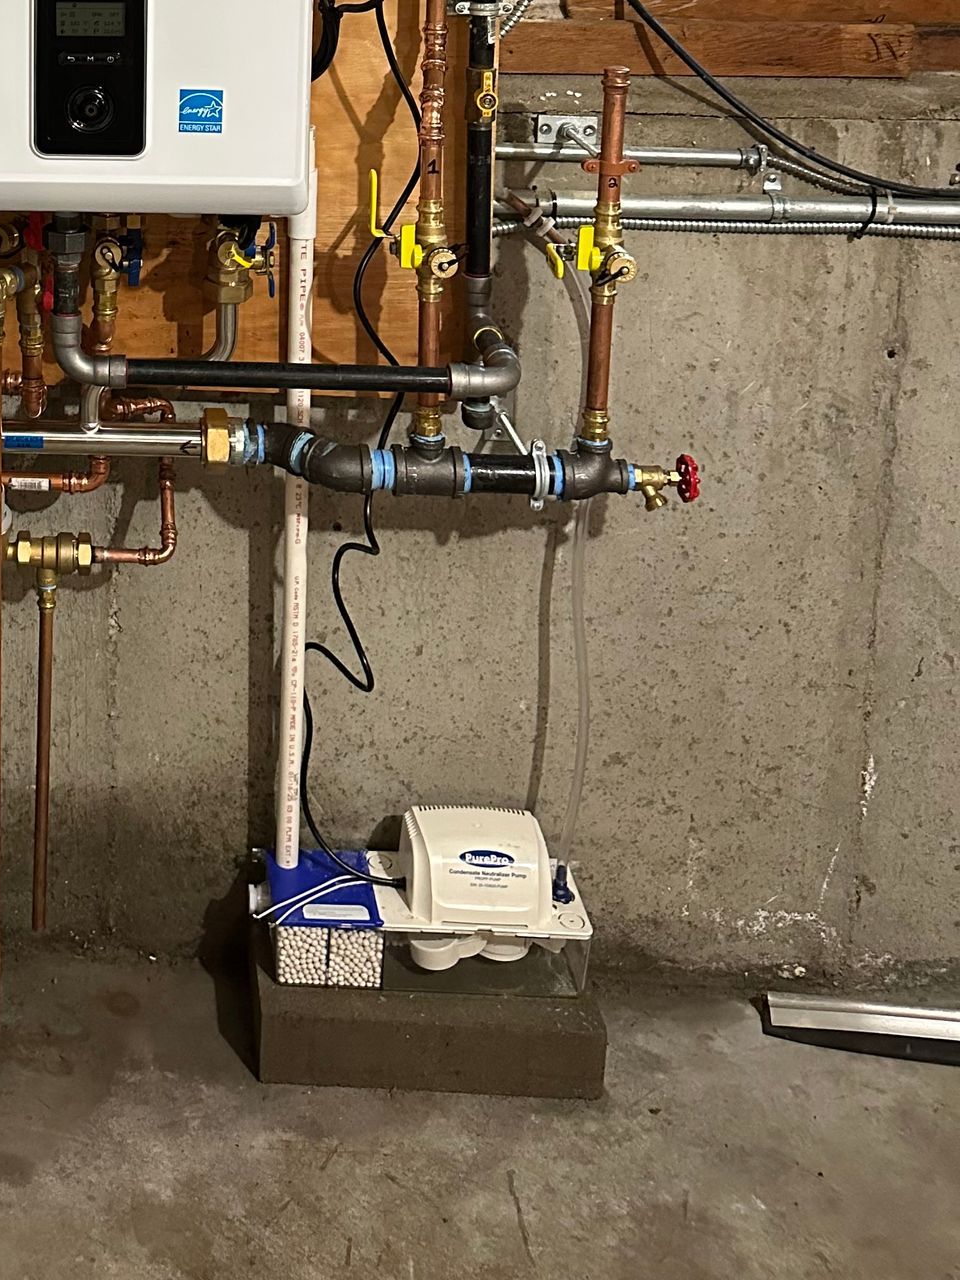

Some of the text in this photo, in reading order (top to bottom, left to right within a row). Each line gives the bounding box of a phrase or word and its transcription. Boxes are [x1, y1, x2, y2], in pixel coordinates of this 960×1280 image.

[180, 124, 204, 132] ENERGY
[427, 158, 440, 174] 1
[608, 177, 618, 188] 2
[299, 268, 307, 302] PIPE
[292, 602, 300, 619] ASTM
[289, 733, 296, 742] IN
[465, 853, 510, 866] PurePro
[448, 868, 481, 876] Condensate
[511, 872, 527, 880] Pump
